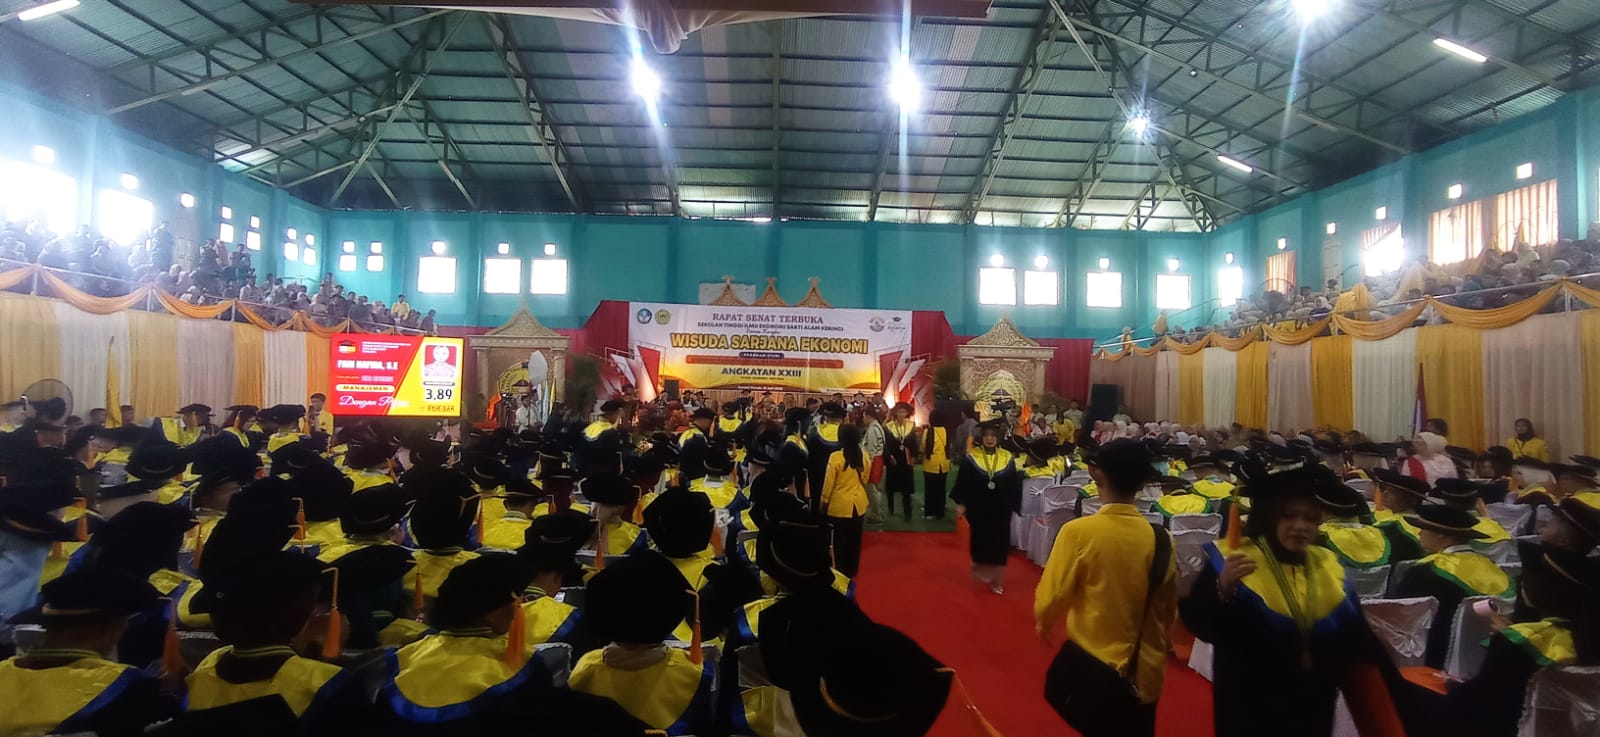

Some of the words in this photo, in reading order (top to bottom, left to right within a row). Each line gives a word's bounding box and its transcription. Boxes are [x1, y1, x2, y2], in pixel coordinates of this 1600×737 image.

[712, 313, 743, 321] RAPAT
[746, 314, 776, 322] SENAT
[779, 315, 824, 324] TERBUKA
[670, 332, 729, 349] WISUDA
[730, 334, 798, 352] SARJANA
[799, 336, 868, 354] EKONOMI
[721, 367, 776, 376] ANGKATAN
[778, 369, 801, 377] XXIII
[425, 389, 453, 401] 3.89
[339, 395, 377, 409] Dengan
